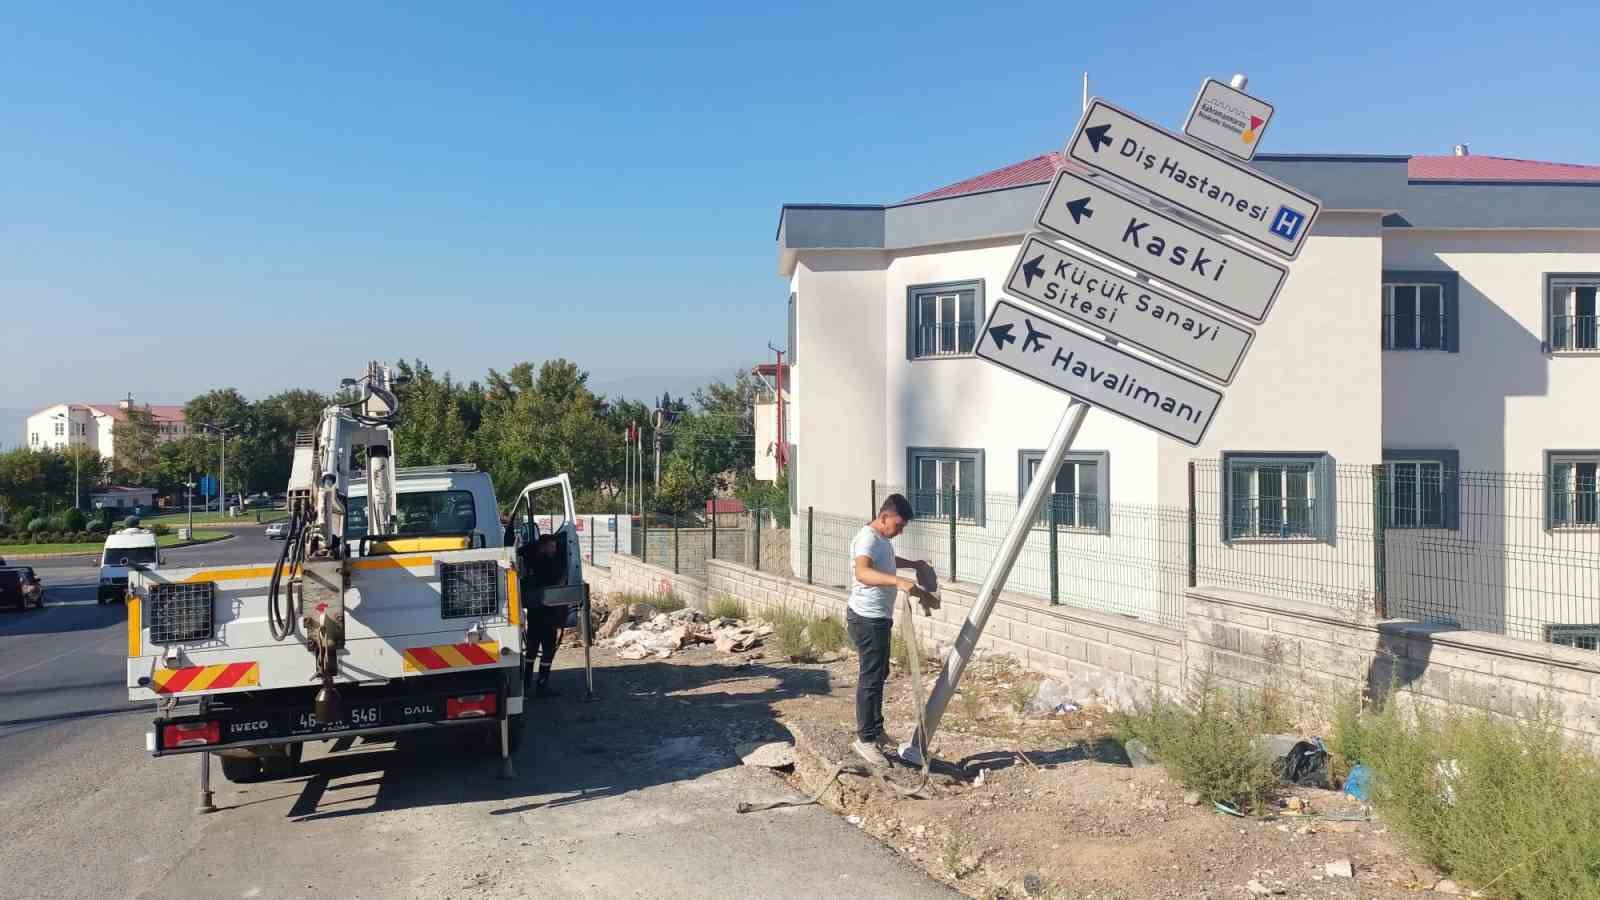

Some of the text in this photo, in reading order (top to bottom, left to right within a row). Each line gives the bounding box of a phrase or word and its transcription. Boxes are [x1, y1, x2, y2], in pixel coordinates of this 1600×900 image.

[1119, 137, 1298, 236] Diş Hastanesi H
[1121, 217, 1228, 282] Kaski
[1043, 282, 1119, 323] Sitesi
[1054, 259, 1221, 341] Küçük Sanayi
[1051, 346, 1203, 424] Havalimanı
[231, 721, 269, 732] IVECO
[300, 713, 317, 728] 46
[352, 708, 377, 724] 546
